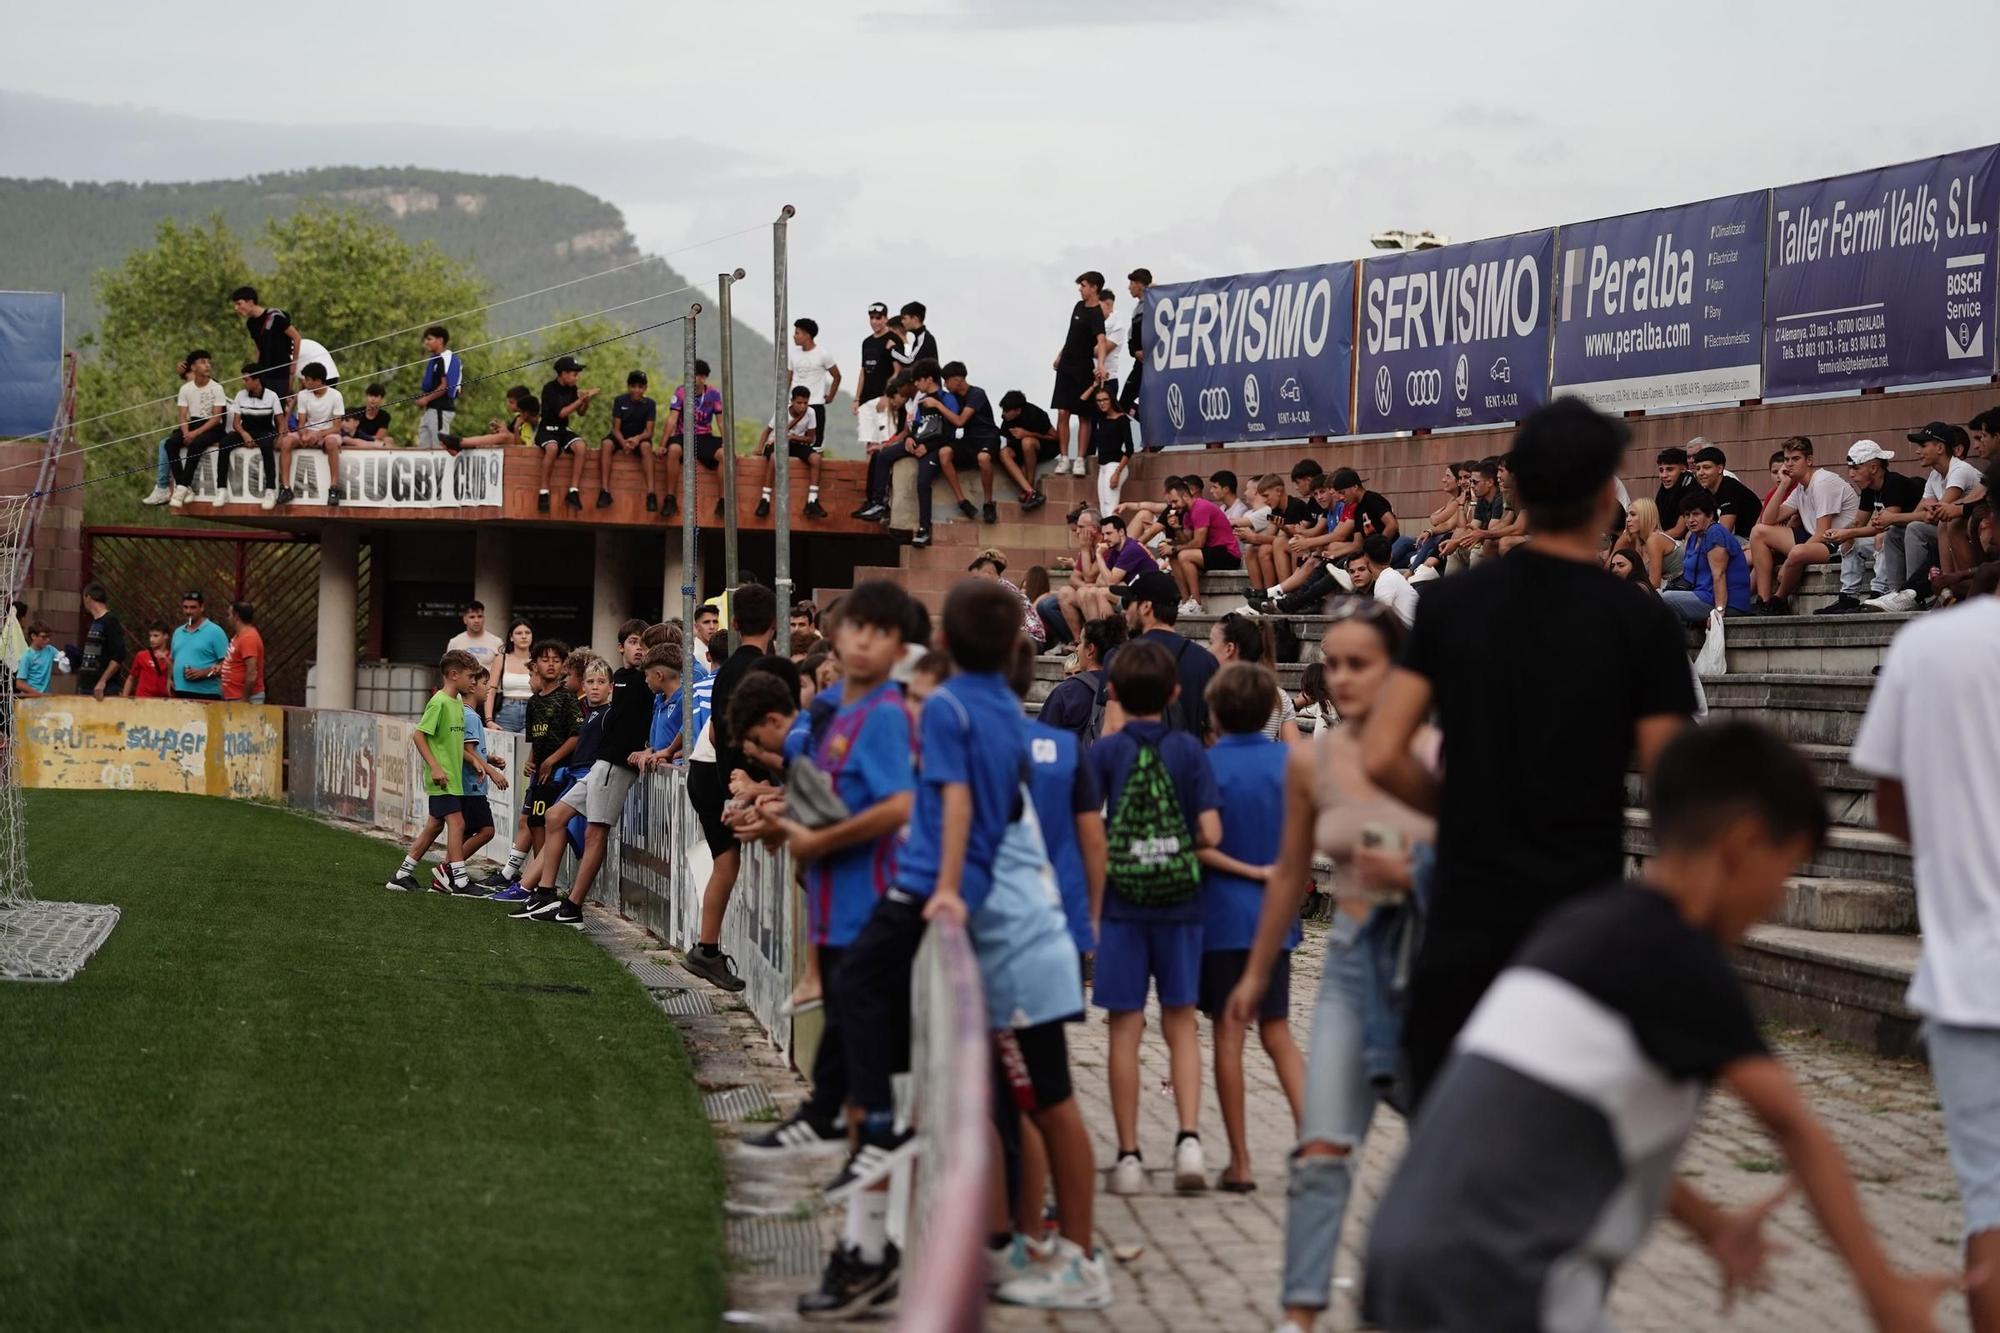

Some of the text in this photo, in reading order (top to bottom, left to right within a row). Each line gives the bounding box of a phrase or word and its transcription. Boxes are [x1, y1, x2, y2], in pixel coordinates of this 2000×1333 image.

[1778, 174, 1988, 266] Taller Fermí Valls, S.L.
[1586, 233, 1694, 318] Peralba
[1947, 271, 1982, 296] BOSCH
[1367, 254, 1539, 355] SERVISIMO
[1946, 298, 1981, 320] Service
[1152, 278, 1331, 372] SERVISIMO
[1809, 323, 1816, 338] 33
[1817, 325, 1828, 337] nau
[1855, 314, 1885, 332] IGUALADA
[1585, 321, 1690, 362] www.peralba.com
[1782, 345, 1795, 359] Tels.
[1838, 338, 1849, 353] Fax
[1485, 393, 1518, 408] RENT-A-CAR
[1278, 410, 1311, 424] RENT-A-CAR
[191, 453, 487, 503] ANOA RUGBY CLUB
[126, 724, 206, 760] super
[532, 800, 546, 816] 10
